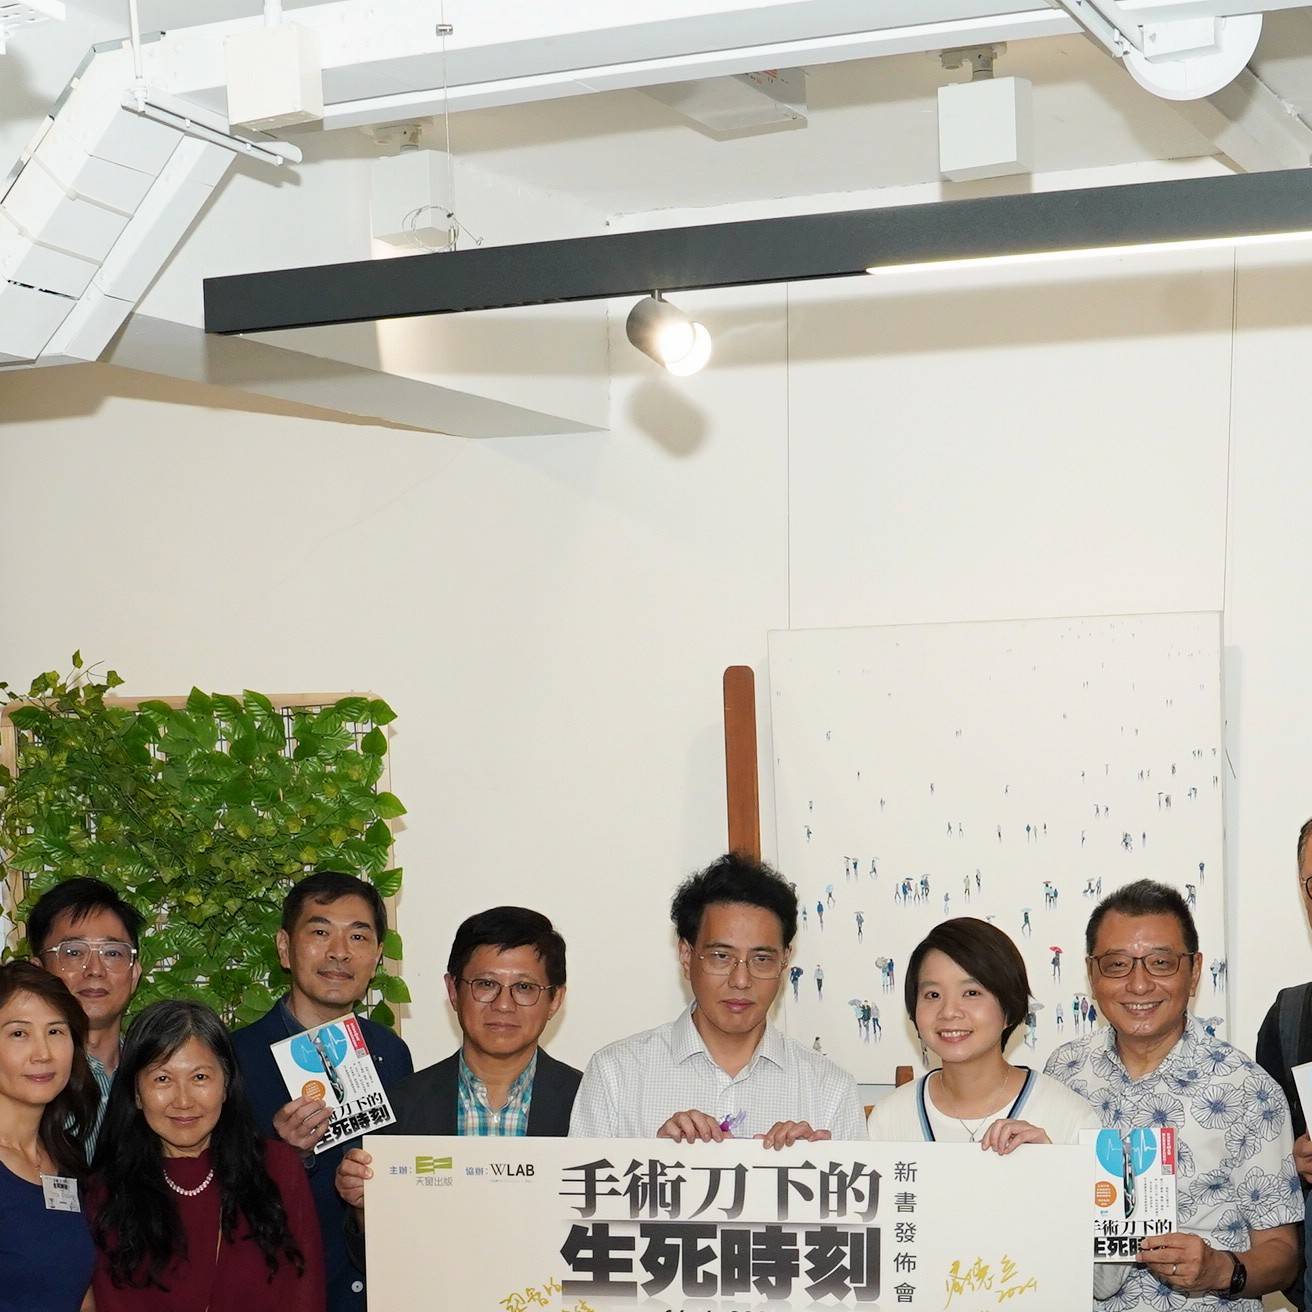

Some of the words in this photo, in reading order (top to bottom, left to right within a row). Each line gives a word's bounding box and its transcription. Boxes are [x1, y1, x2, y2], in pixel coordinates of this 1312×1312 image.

[490, 1163, 535, 1177] WLAB
[559, 1158, 882, 1222] 手術刀下的
[559, 1222, 882, 1302] 生死時刻
[893, 1160, 918, 1304] 新書發佈會
